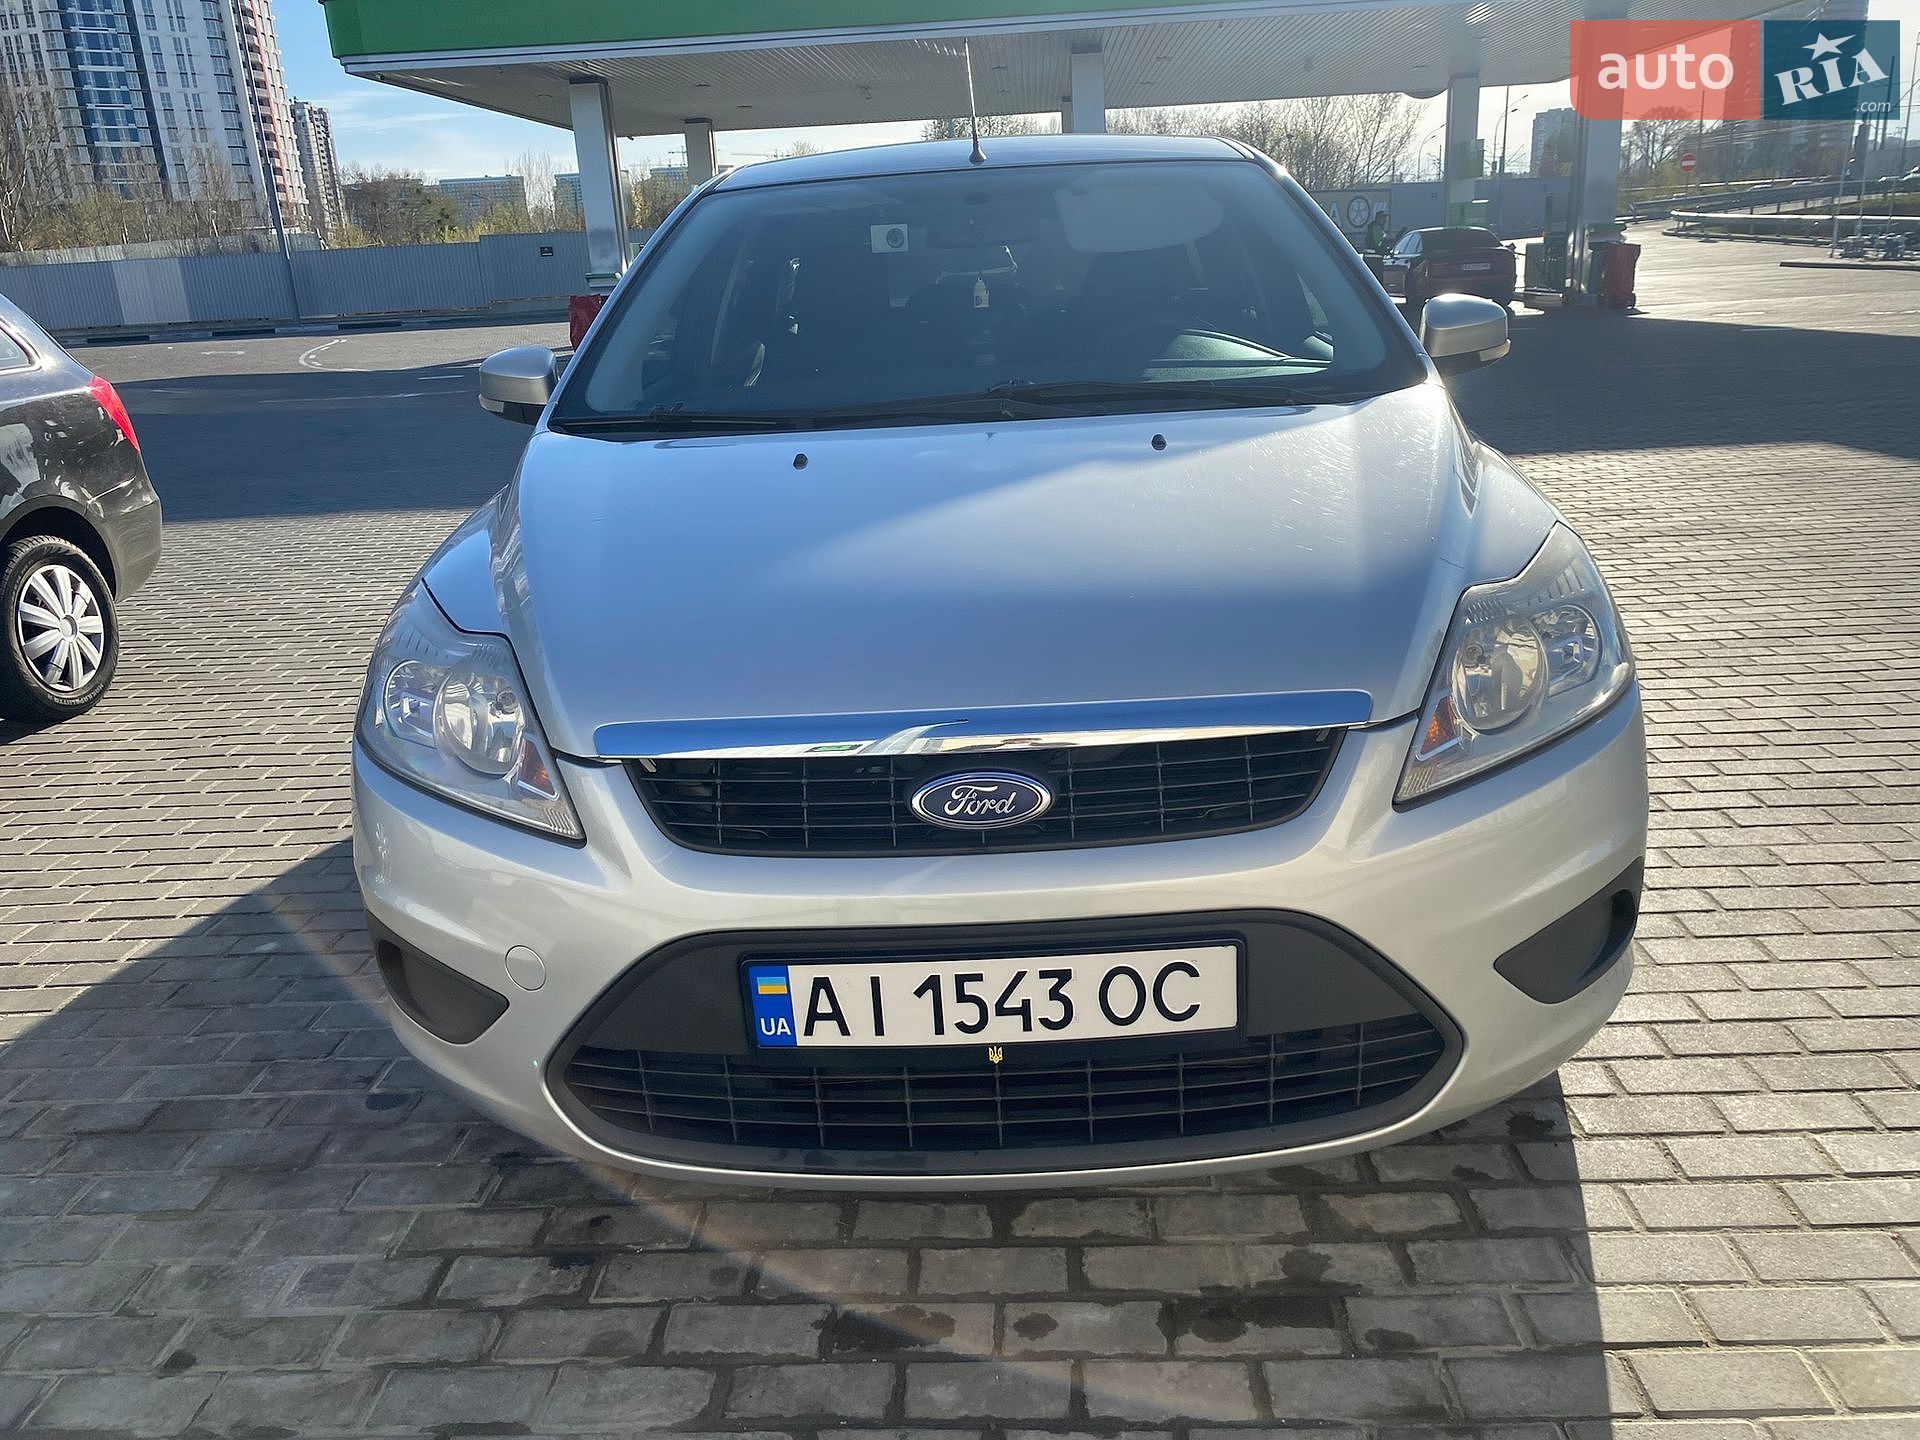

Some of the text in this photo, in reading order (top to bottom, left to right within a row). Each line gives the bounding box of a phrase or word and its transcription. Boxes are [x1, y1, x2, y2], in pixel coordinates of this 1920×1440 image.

[944, 785, 1016, 816] Ford
[912, 967, 1074, 1037] 1543
[1098, 960, 1201, 1027] OC
[760, 1017, 792, 1036] UA
